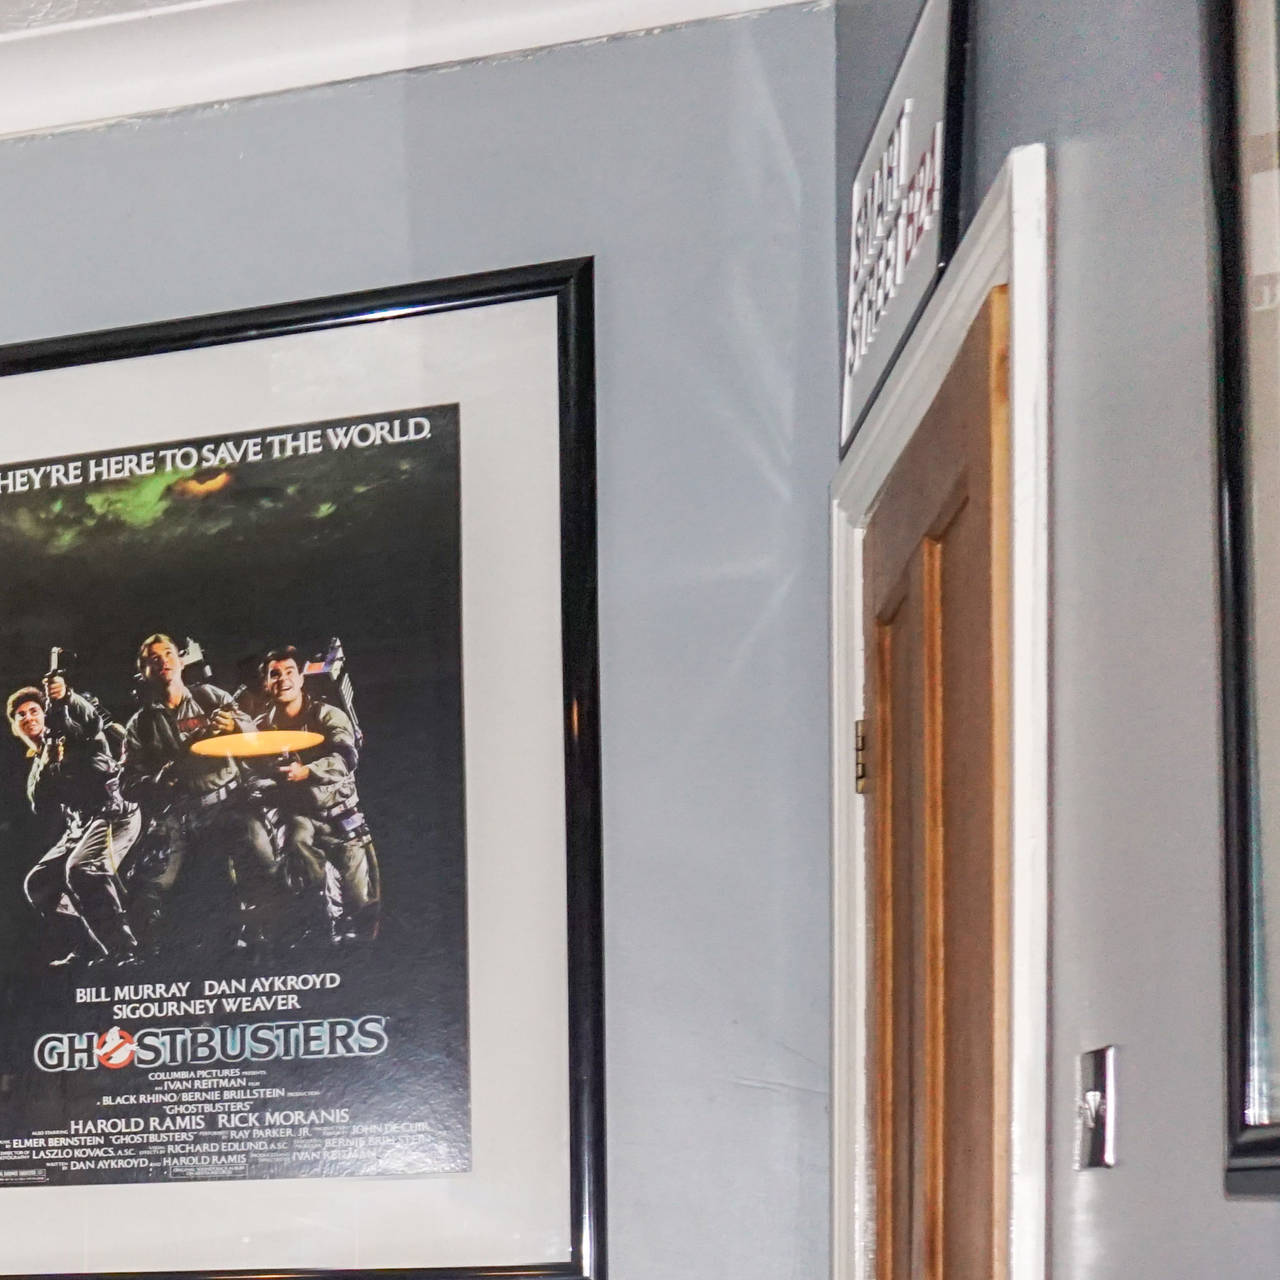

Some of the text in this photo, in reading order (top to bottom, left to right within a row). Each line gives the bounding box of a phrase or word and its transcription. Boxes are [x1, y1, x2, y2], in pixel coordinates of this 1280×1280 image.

[88, 452, 154, 482] HERE
[160, 445, 198, 472] TO
[201, 438, 263, 467] SAVE
[266, 430, 323, 458] THE
[75, 972, 341, 1003] BILL MURRAY DAN AYKROYD
[112, 993, 302, 1020] SIGOURNEY WEAVER
[148, 1070, 196, 1081] COLUMBIA
[196, 1068, 241, 1078] PICTURES
[163, 1080, 193, 1091] IVAN
[194, 1078, 247, 1090] REITMAN
[102, 1095, 137, 1106] BLACK
[223, 1087, 285, 1100] BRILLSTEIN
[70, 1118, 145, 1135] HAROLD
[149, 1115, 205, 1132] RAMIS
[218, 1110, 260, 1128] RICK
[264, 1108, 350, 1126] MORANIS
[13, 1137, 47, 1149] ELMER
[48, 1135, 105, 1148] BERNSTEIN
[229, 1129, 251, 1140] RAY
[32, 1149, 72, 1160] LASZLO
[167, 1142, 220, 1154] RICHARD
[70, 1160, 96, 1171] DAN
[97, 1158, 149, 1170] AYKROYD
[163, 1154, 212, 1167] HAROLD
[213, 1153, 247, 1164] RAMIS
